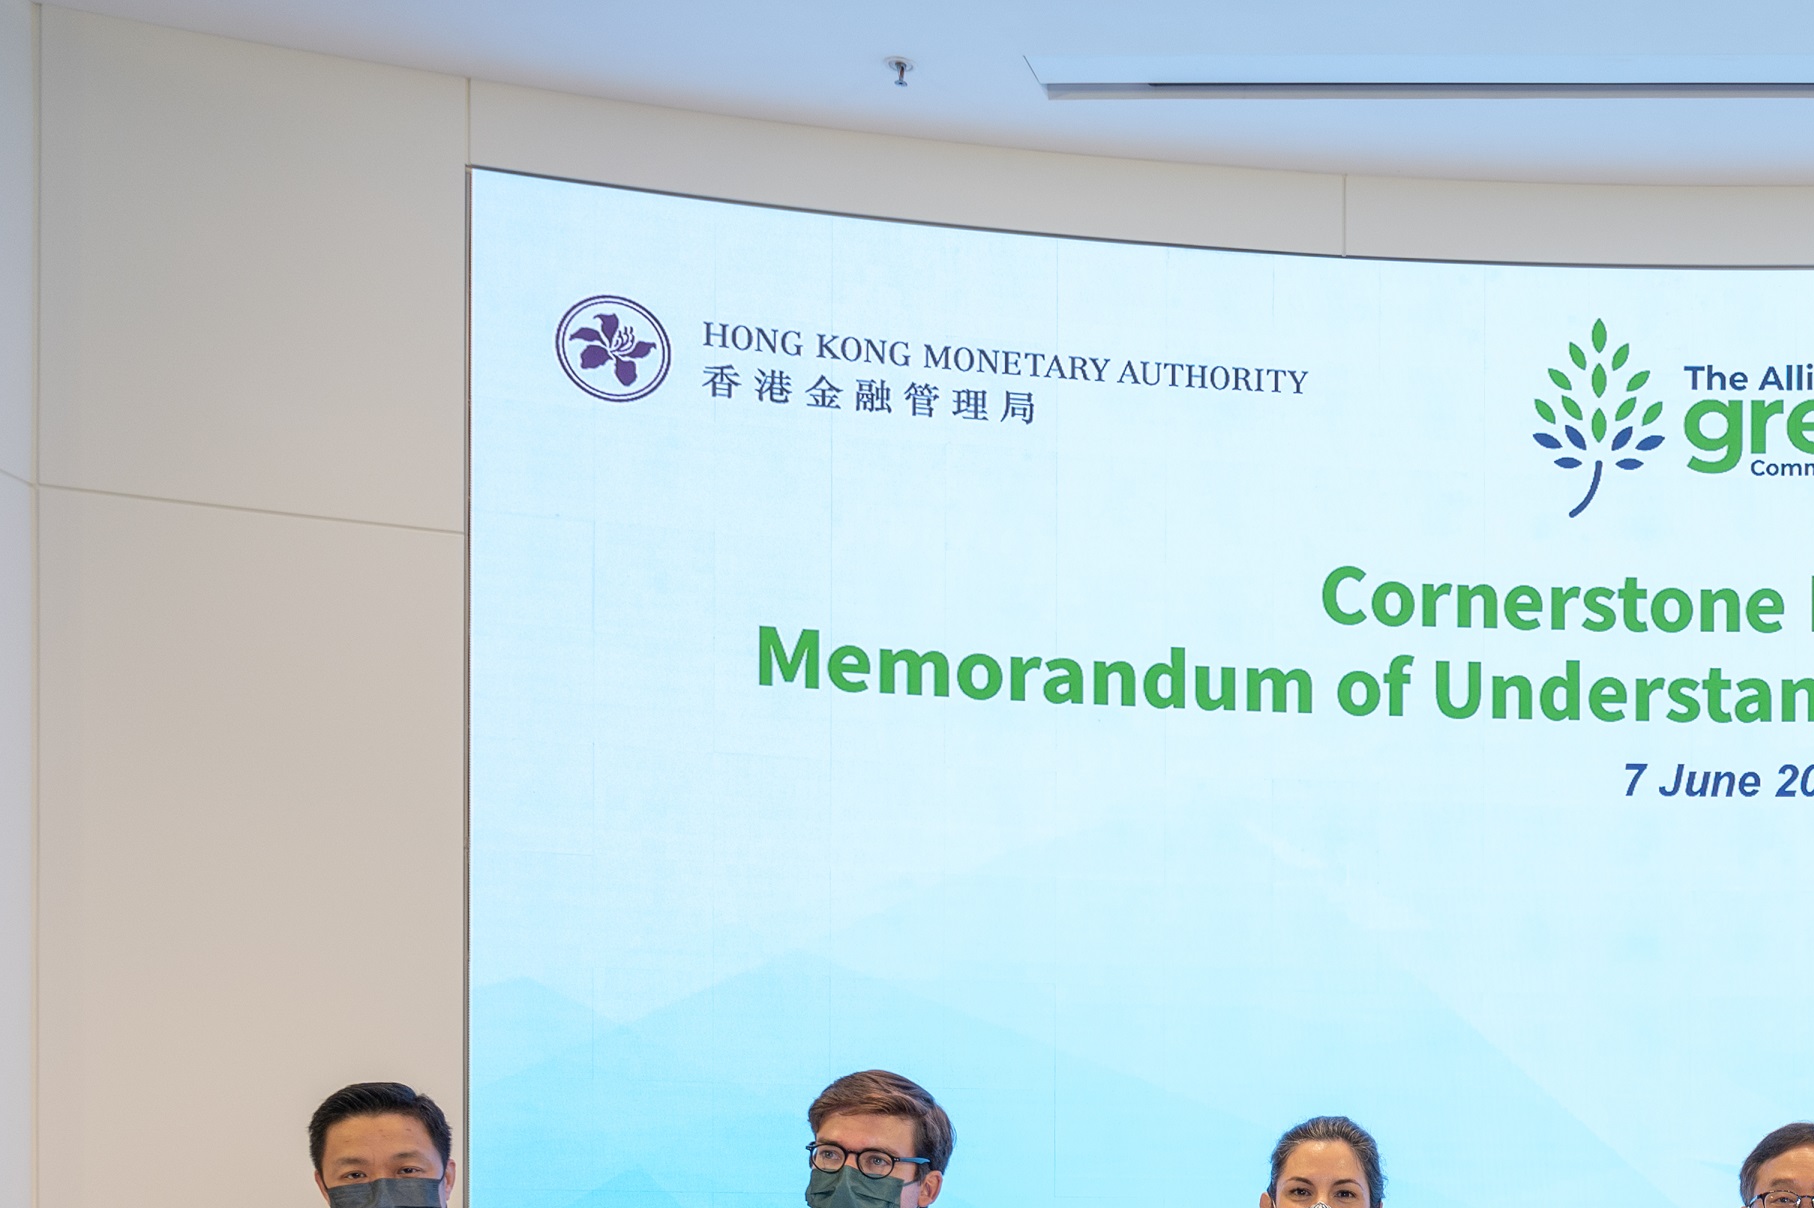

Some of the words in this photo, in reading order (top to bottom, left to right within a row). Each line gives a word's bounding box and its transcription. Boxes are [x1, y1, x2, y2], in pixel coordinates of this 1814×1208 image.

[703, 321, 803, 357] HONG
[816, 333, 911, 367] KONG
[924, 344, 1110, 385] MONETARY
[1117, 360, 1308, 395] AUTHORITY
[1684, 365, 1748, 391] The
[702, 364, 1034, 425] 香港金融管理局
[1322, 566, 1784, 633] Cornerstone
[759, 626, 1312, 713] Memorandum
[1337, 655, 1415, 716] of
[1625, 763, 1648, 796] 7
[1658, 764, 1760, 797] June
